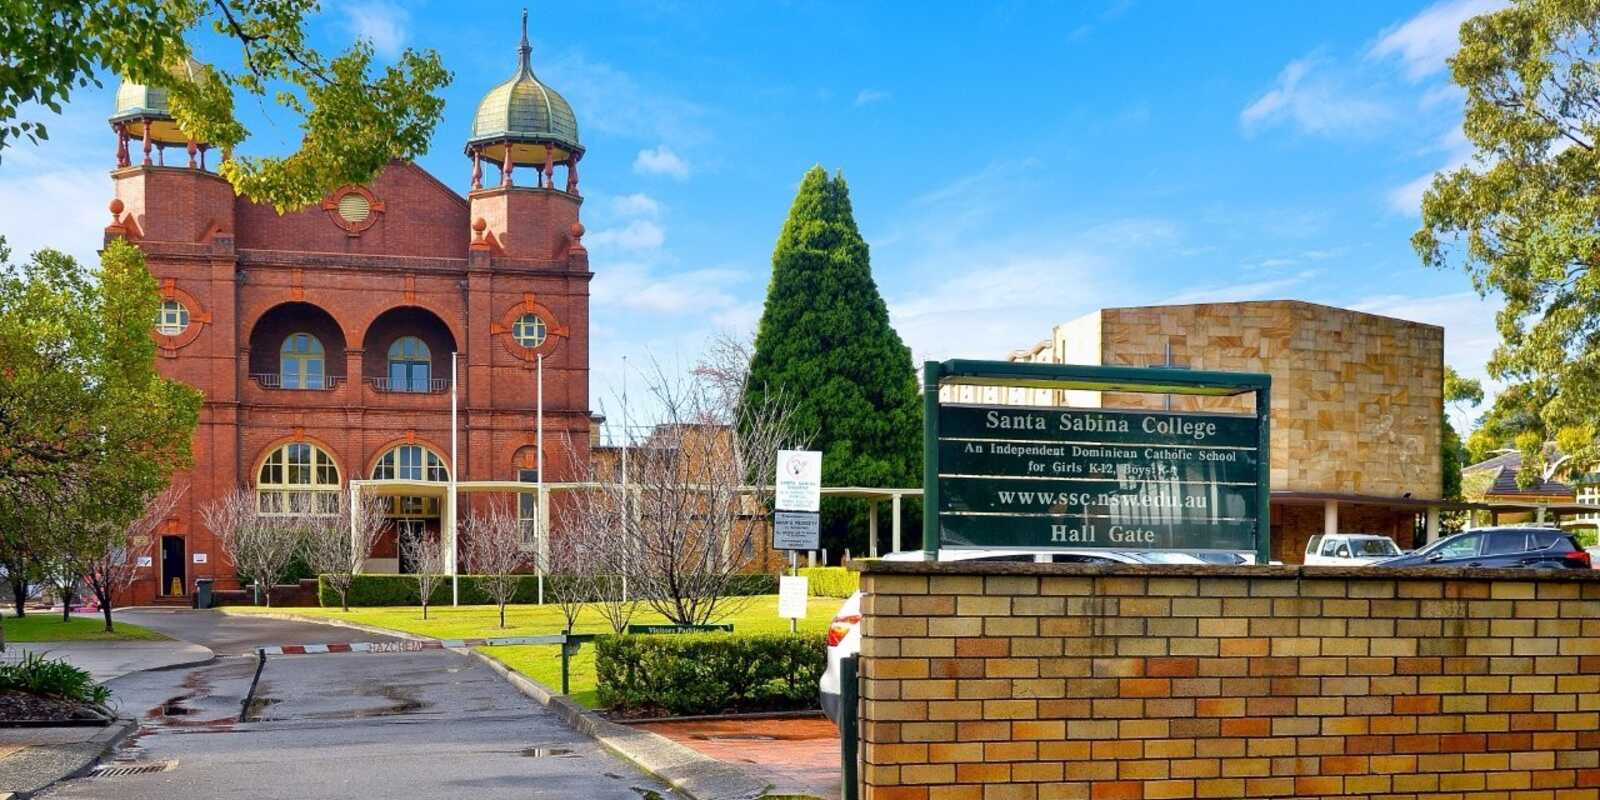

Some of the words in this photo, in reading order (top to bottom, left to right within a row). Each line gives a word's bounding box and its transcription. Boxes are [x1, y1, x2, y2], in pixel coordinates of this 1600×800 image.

[986, 410, 1047, 431] Santa
[1059, 413, 1130, 433] Sabina
[1142, 416, 1217, 439] College
[964, 443, 984, 454] An
[990, 443, 1065, 457] Independent
[1072, 446, 1138, 459] Dominican
[1144, 447, 1193, 461] Catholic
[1199, 449, 1237, 462] School
[1027, 461, 1045, 473] for
[1052, 462, 1083, 474] Girls
[998, 488, 1207, 508] www.ssc.nsw.edu.au
[1050, 524, 1096, 543] Hall
[1108, 525, 1156, 543] Gate
